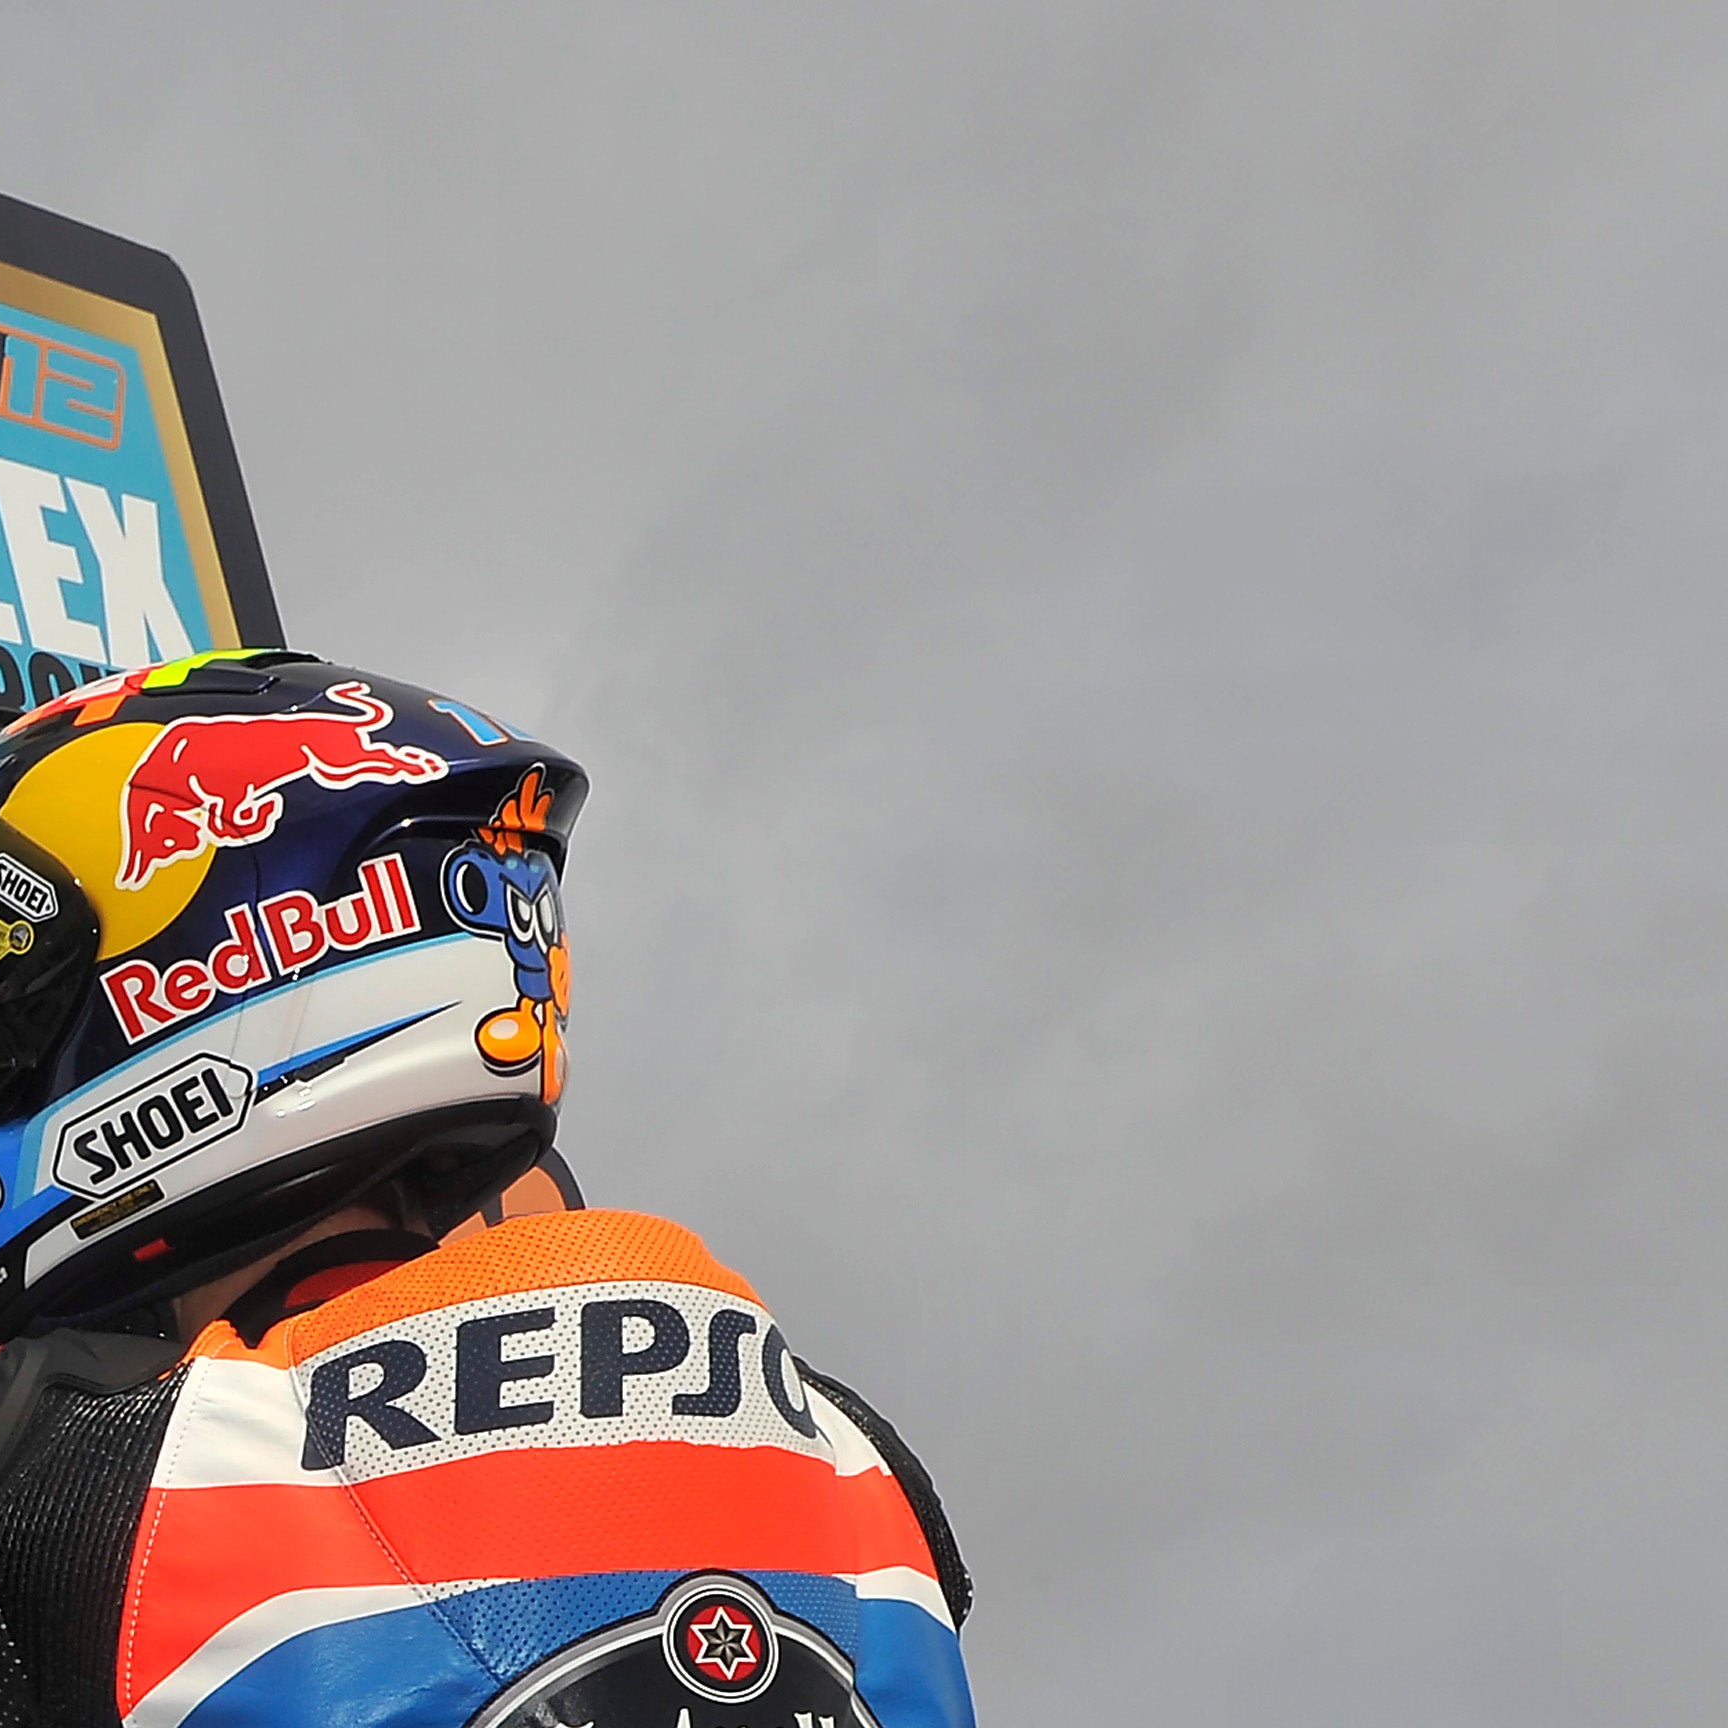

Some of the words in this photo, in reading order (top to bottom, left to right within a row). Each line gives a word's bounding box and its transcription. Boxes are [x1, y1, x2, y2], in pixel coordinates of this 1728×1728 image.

[102, 906, 271, 1044] Red
[259, 854, 420, 974] Bull
[73, 1068, 234, 1185] SHOEI
[301, 1298, 830, 1471] REPSO
